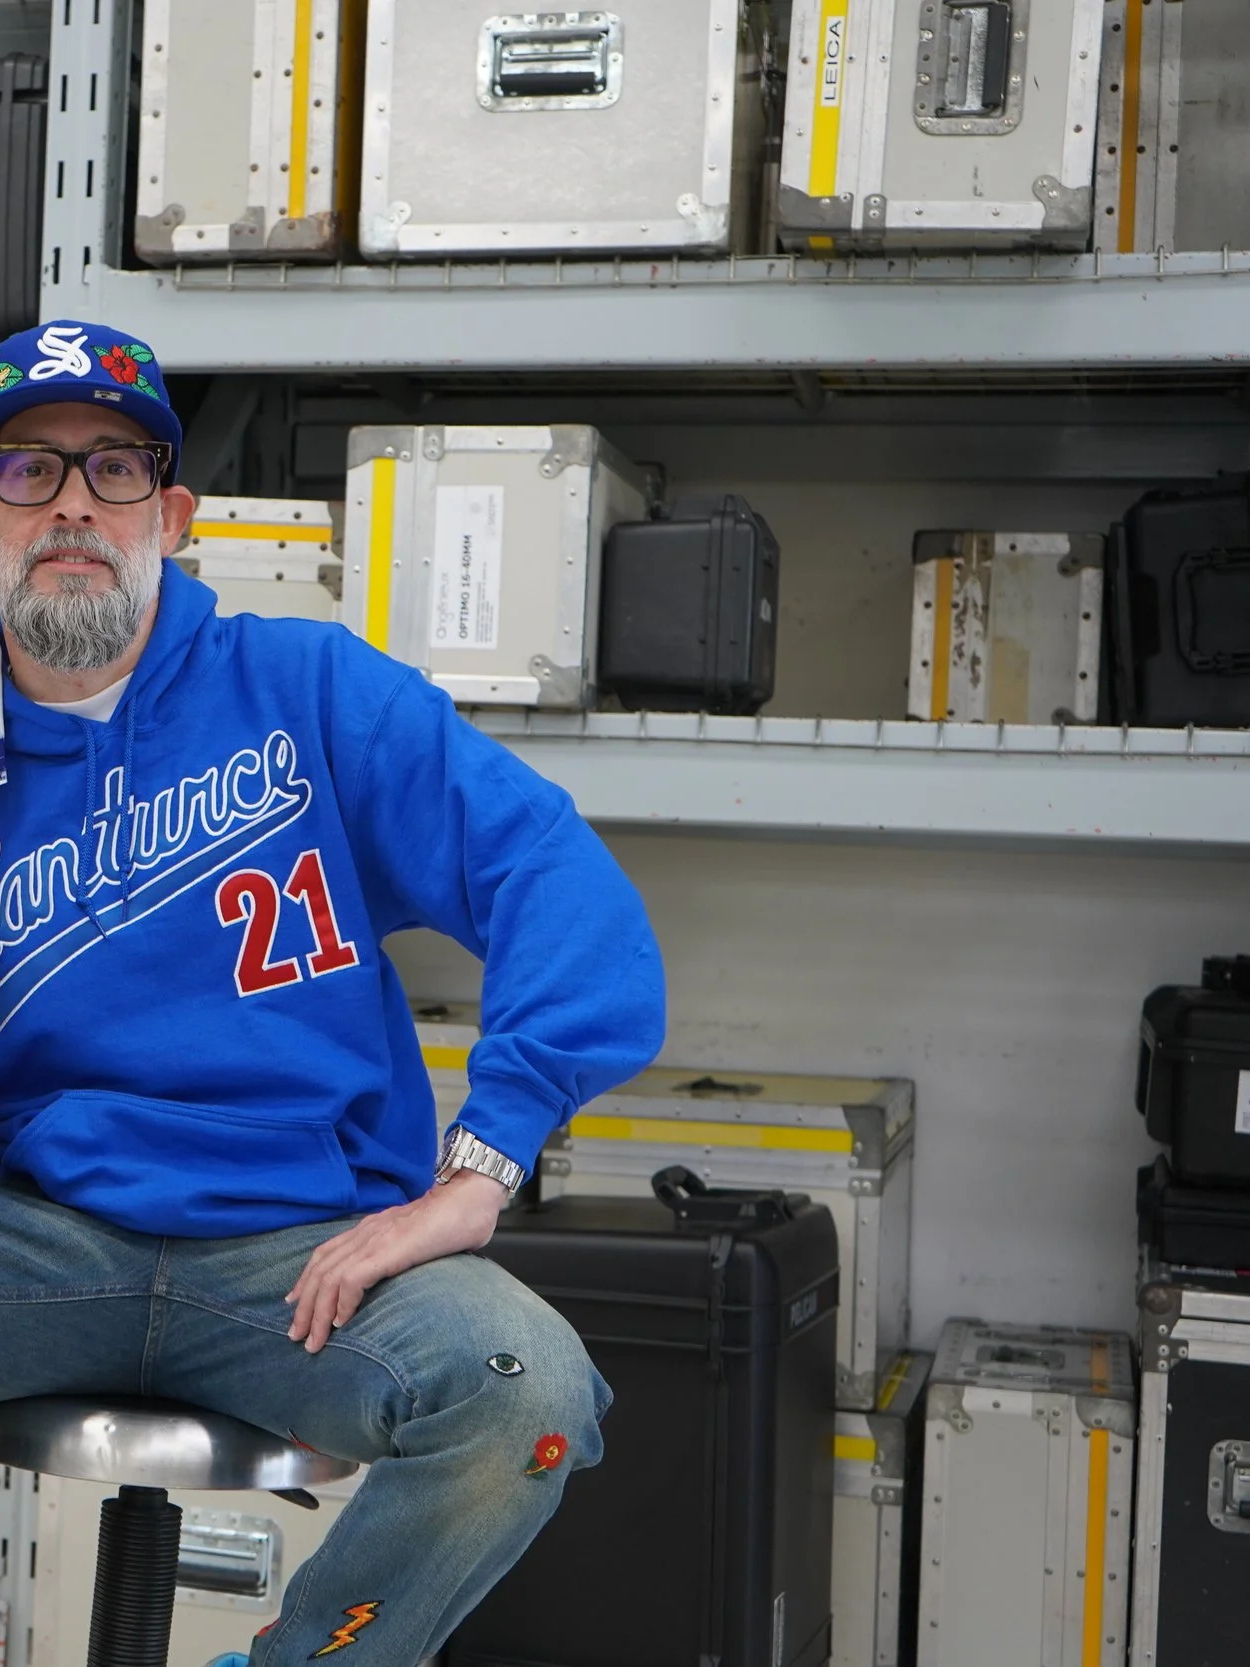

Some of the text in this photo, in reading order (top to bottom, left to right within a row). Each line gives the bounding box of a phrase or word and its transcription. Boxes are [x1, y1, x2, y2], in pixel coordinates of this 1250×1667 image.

[823, 20, 842, 101] LEICA
[458, 534, 472, 640] OPTIMO 16-40MM
[214, 847, 360, 998] 21
